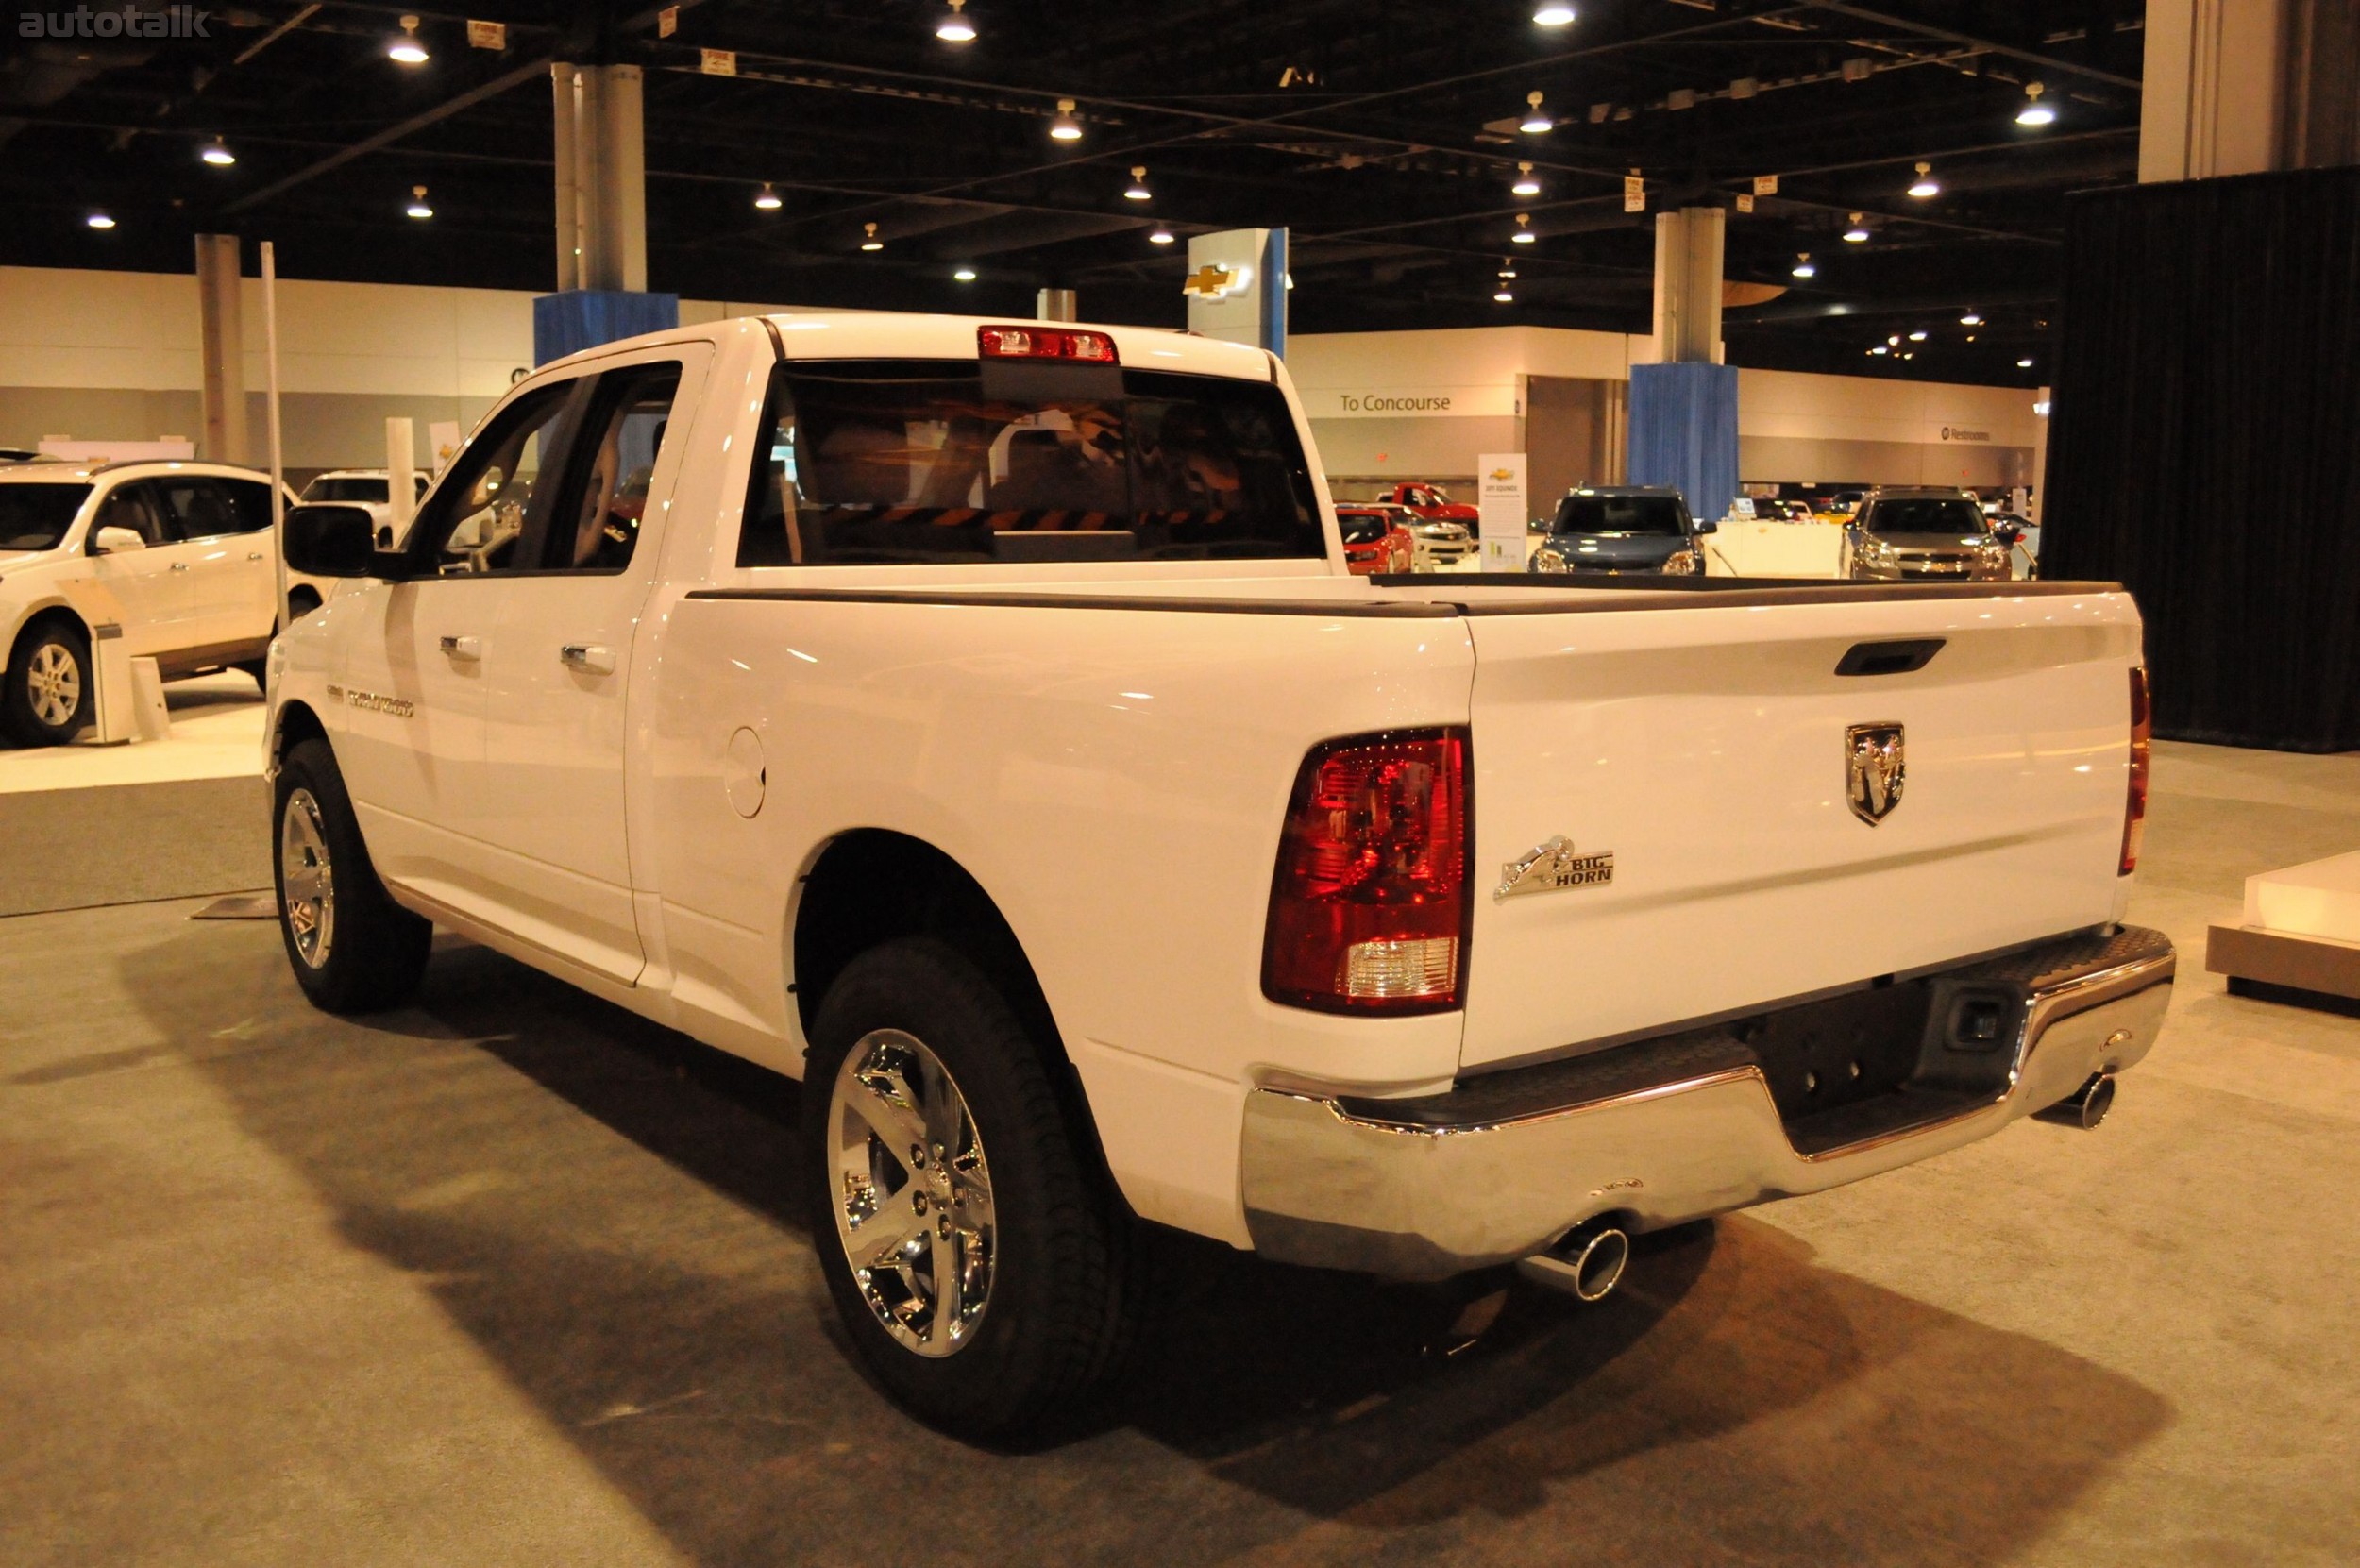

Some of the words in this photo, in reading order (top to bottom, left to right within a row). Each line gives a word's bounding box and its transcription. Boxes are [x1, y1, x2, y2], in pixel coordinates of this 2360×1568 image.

[1340, 395, 1359, 412] To
[1363, 395, 1451, 412] Concourse
[1950, 428, 1990, 442] Restrooms
[1571, 855, 1605, 871] BIG
[1555, 868, 1612, 887] HORN
